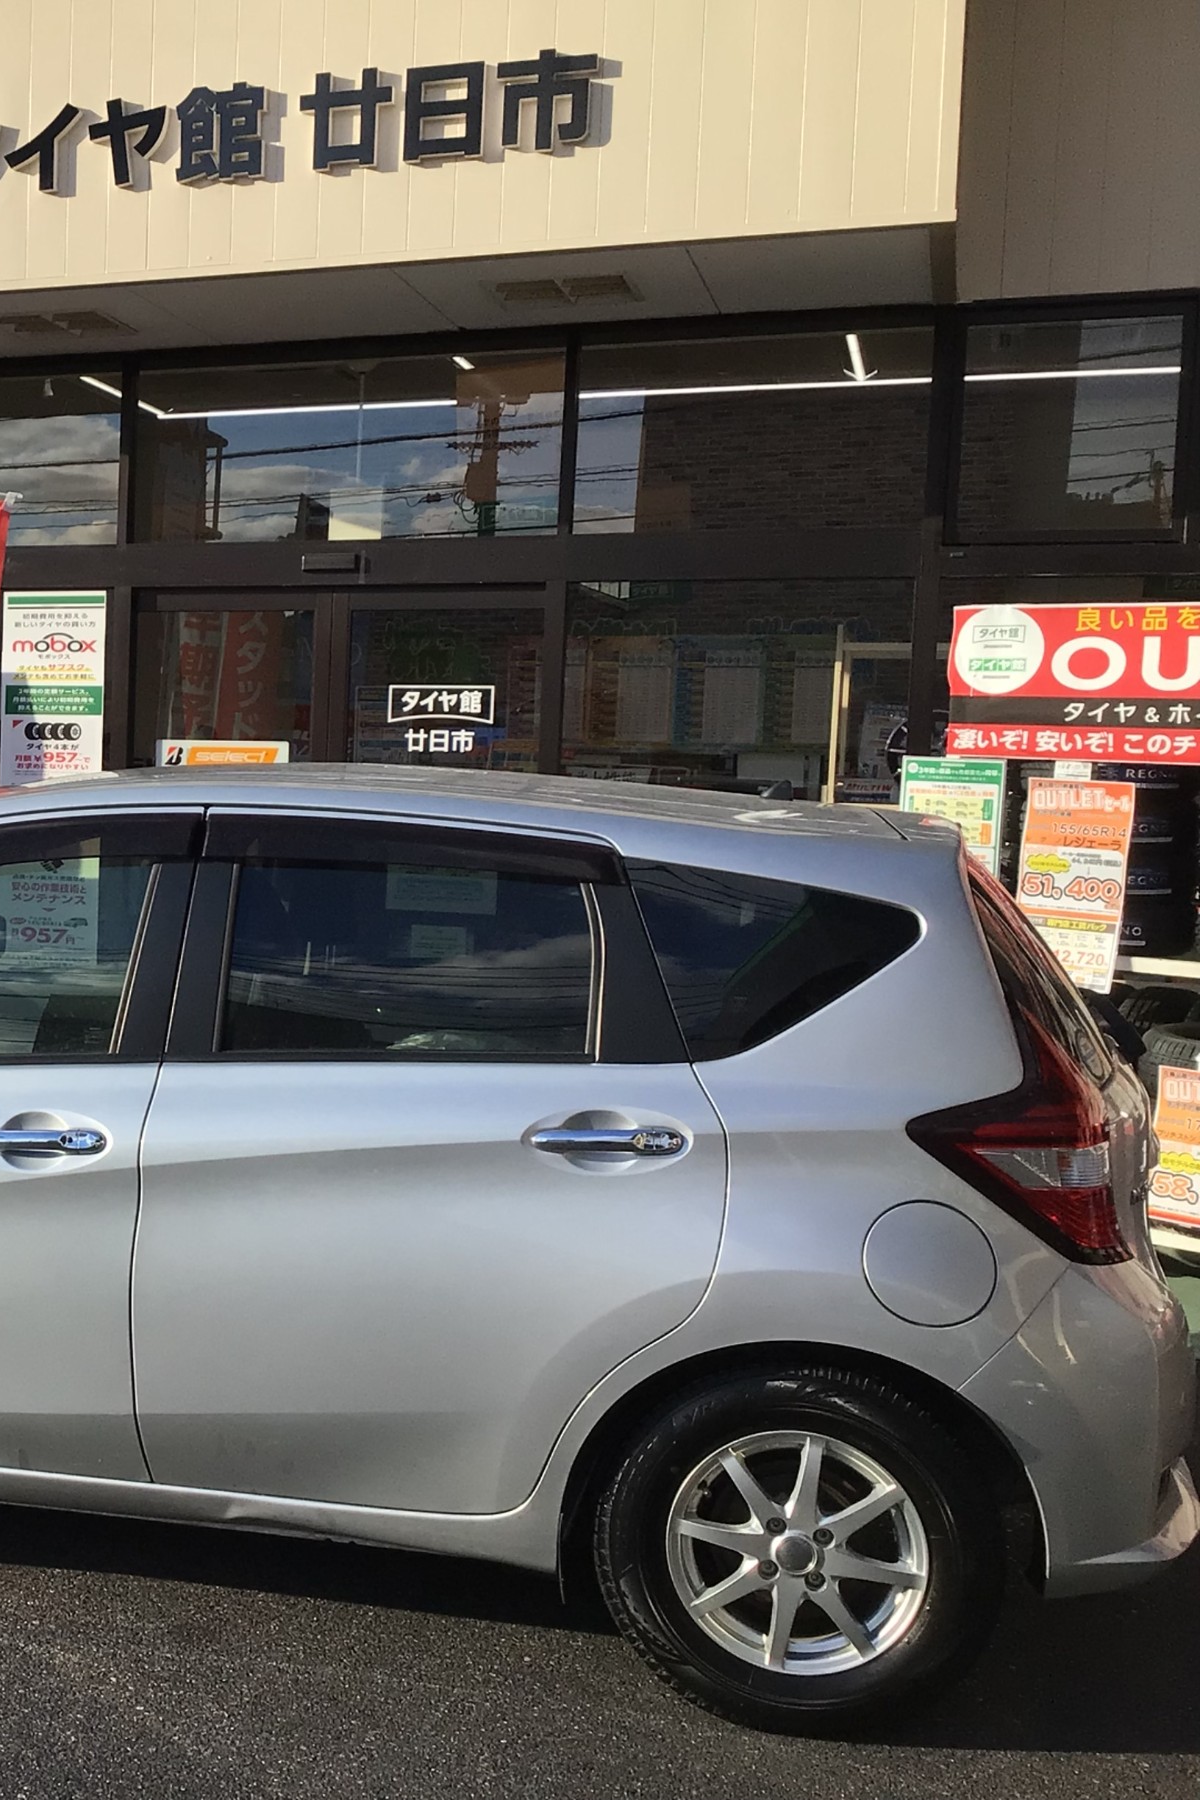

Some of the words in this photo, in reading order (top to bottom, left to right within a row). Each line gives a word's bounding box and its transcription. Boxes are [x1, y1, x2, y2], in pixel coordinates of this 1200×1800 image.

[299, 48, 601, 172] 廿日市
[978, 626, 1020, 639] タイヤ館
[12, 634, 97, 653] mobox
[969, 658, 1026, 672] タイヤ館
[1051, 635, 1200, 691] OU
[400, 690, 483, 714] タイヤ館
[26, 742, 79, 751] タイヤ4本が
[404, 728, 475, 753] 廿日市
[1035, 730, 1114, 752] 安いぞ!
[194, 749, 268, 764] select
[1052, 822, 1127, 839] 155/65R14
[1062, 836, 1122, 850] レジェーラ
[11, 881, 87, 894] 安心の作業技術と
[1022, 873, 1121, 902] 51,400
[11, 893, 87, 905] メンテナンス
